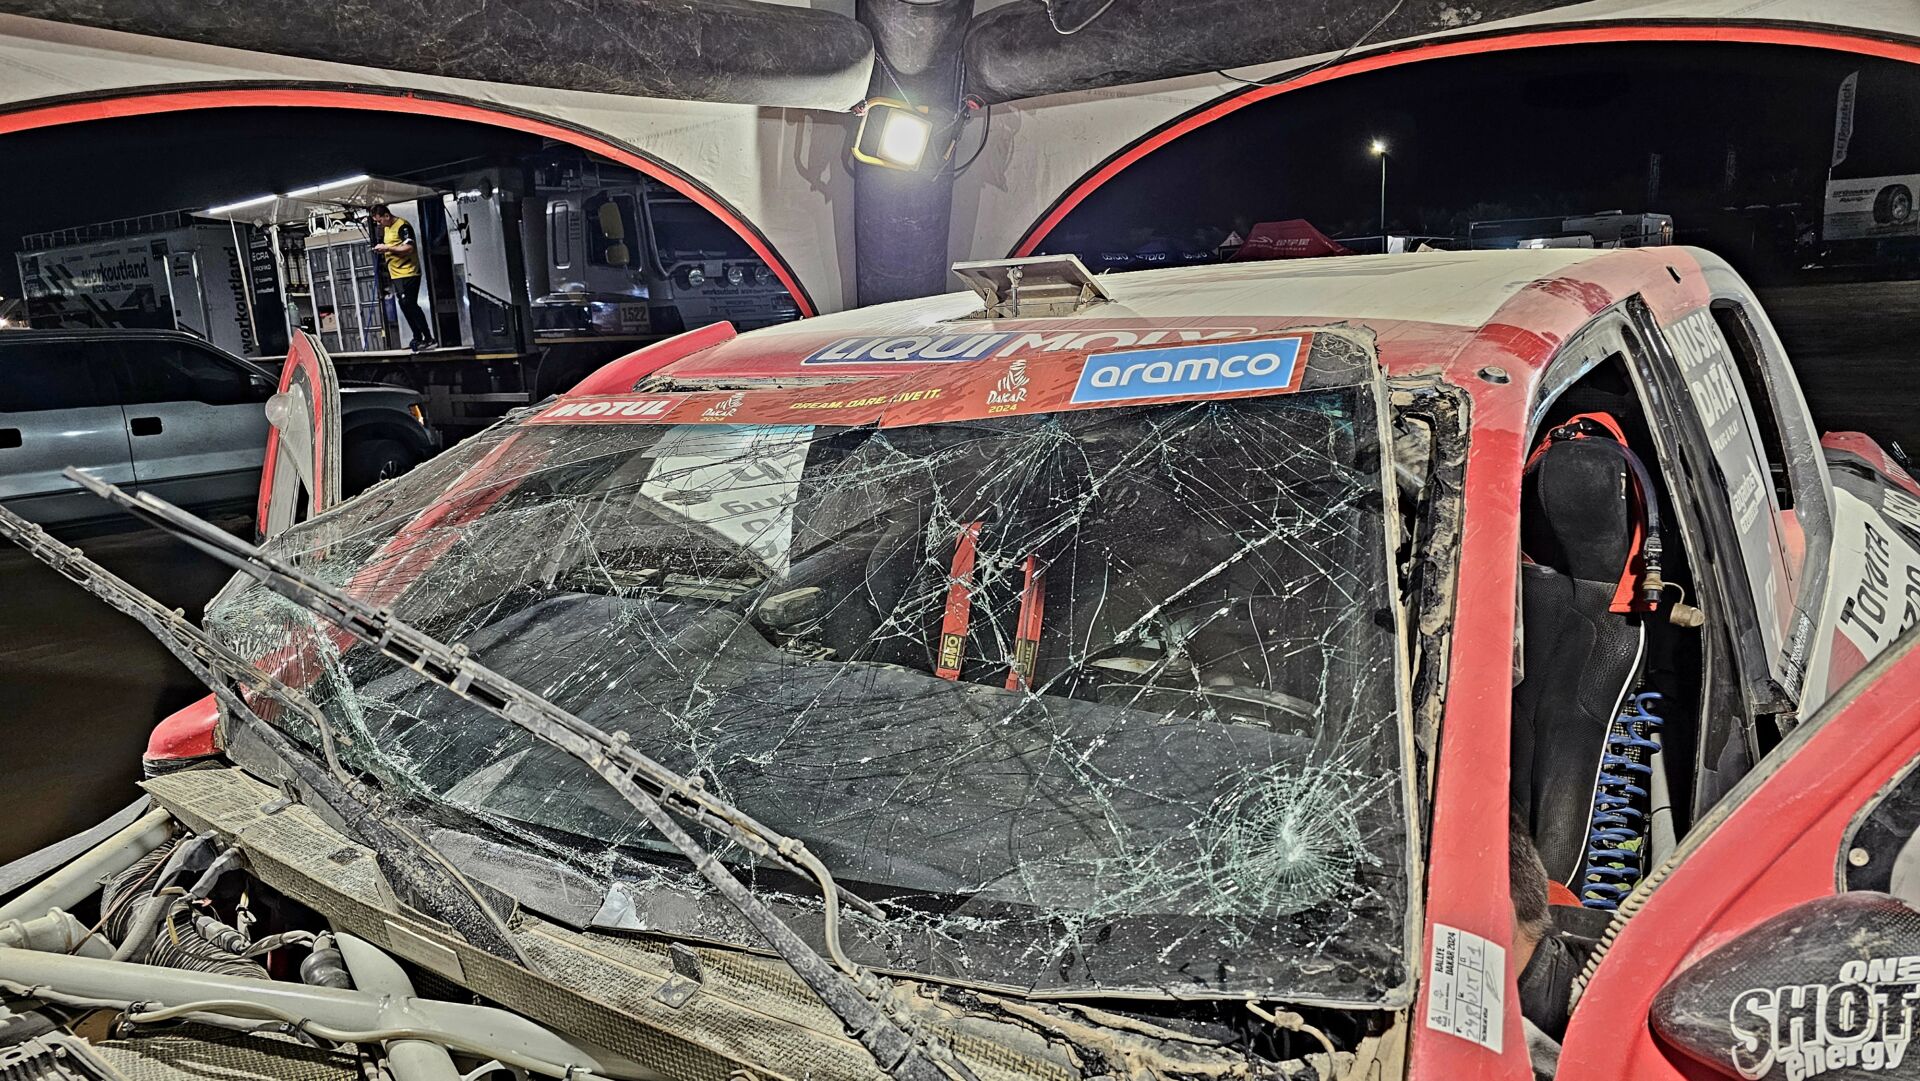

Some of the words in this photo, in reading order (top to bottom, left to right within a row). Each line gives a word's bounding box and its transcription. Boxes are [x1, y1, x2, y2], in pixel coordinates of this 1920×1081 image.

[621, 306, 647, 323] 1522
[821, 332, 1006, 361] LIQUI
[1090, 353, 1281, 388] aramco
[544, 400, 671, 417] MOTUL
[985, 388, 1028, 405] DAKAR
[988, 404, 1018, 414] 2024
[1840, 521, 1890, 644] TOYOTA
[944, 637, 959, 668] OMP
[1447, 932, 1456, 950] 2024
[1435, 947, 1445, 973] RALLYE
[1445, 949, 1455, 976] DAKAR
[1839, 955, 1920, 984] ONE
[1730, 983, 1920, 1081] SHOT
[1785, 1040, 1912, 1081] energy
